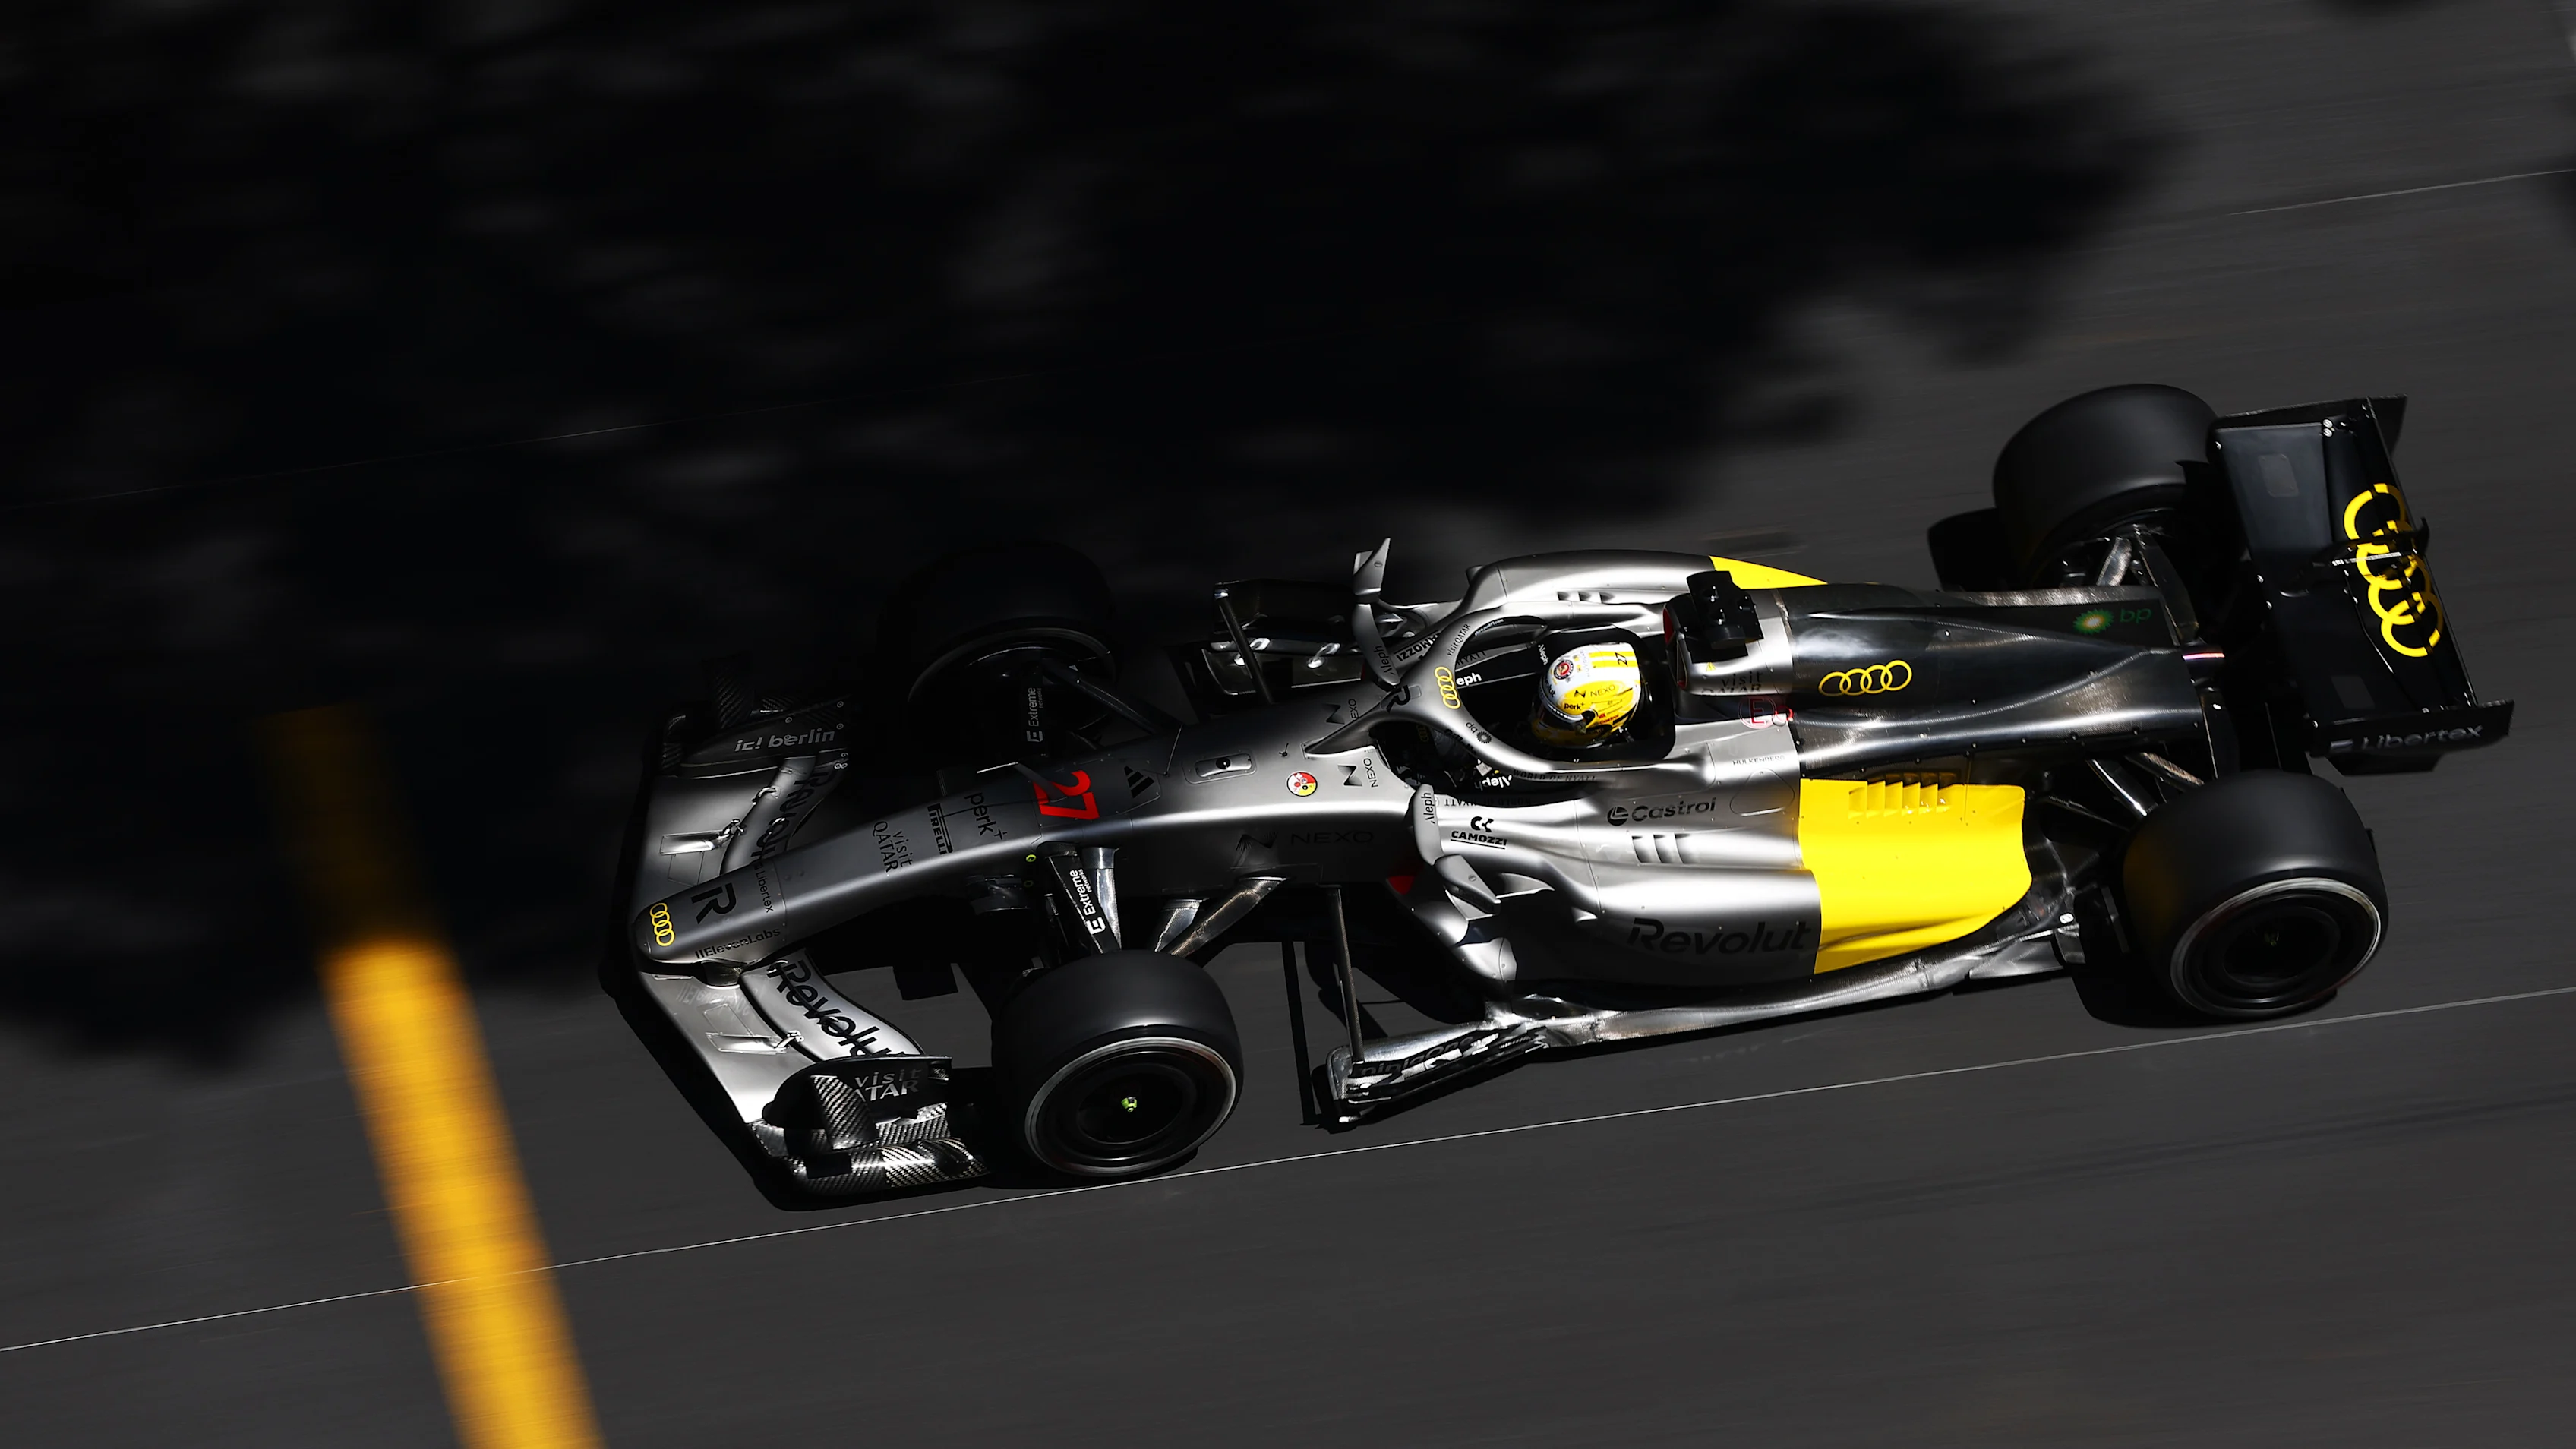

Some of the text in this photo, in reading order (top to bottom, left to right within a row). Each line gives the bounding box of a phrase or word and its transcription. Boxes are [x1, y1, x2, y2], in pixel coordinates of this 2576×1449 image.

[2119, 608, 2154, 624] bp
[1614, 652, 1629, 667] 27
[1456, 671, 1482, 687] eph
[1590, 684, 1616, 698] NEXO
[1721, 671, 1763, 687] visit
[1027, 687, 1040, 727] Extreme
[1347, 698, 1359, 722] EXO
[1384, 684, 1411, 713] R
[767, 728, 835, 749] berlin
[2361, 724, 2484, 751] Libertex
[1362, 758, 1379, 788] NEXO
[1513, 769, 1546, 781] WORLD
[1032, 769, 1101, 821] 27
[750, 769, 837, 858] Revolu
[1631, 797, 1716, 822] Castrol
[927, 803, 953, 855] PIRELLI
[1290, 831, 1374, 845] NEXO
[1451, 830, 1507, 847] CAMOZZI
[872, 821, 898, 873] QATAR
[892, 830, 913, 867] visit
[690, 882, 737, 924] R
[755, 870, 774, 914] Libertex
[1069, 870, 1097, 916] Extreme
[1627, 917, 1812, 955] Revolut
[766, 959, 906, 1058] Revolu
[853, 1079, 920, 1103] TAR
[854, 1068, 923, 1088] visit
